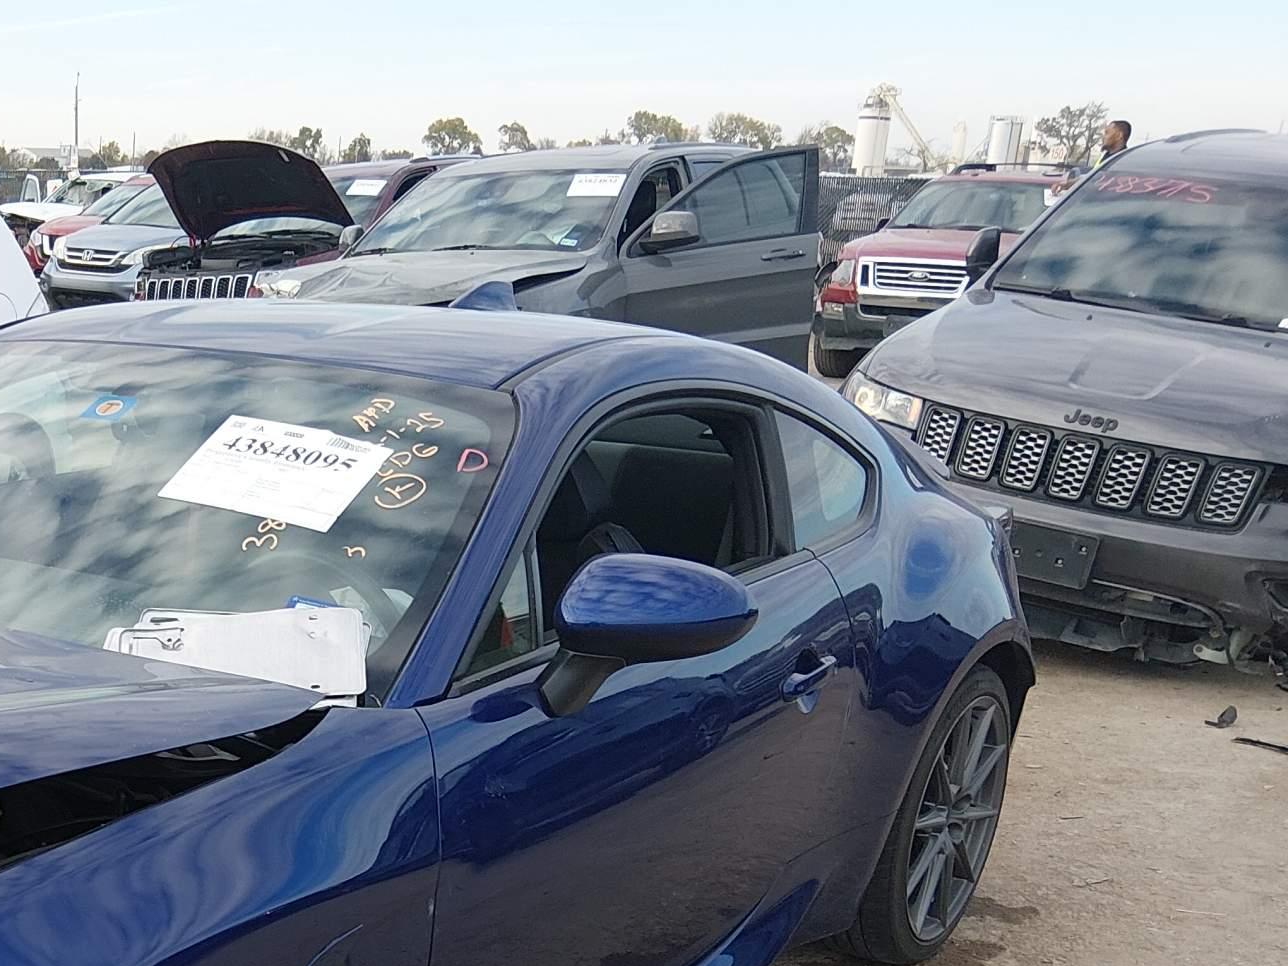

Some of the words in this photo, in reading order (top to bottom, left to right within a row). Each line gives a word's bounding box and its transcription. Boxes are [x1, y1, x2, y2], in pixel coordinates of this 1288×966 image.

[1063, 409, 1119, 433] Jeep
[223, 435, 359, 472] 43848095
[456, 448, 489, 472] D
